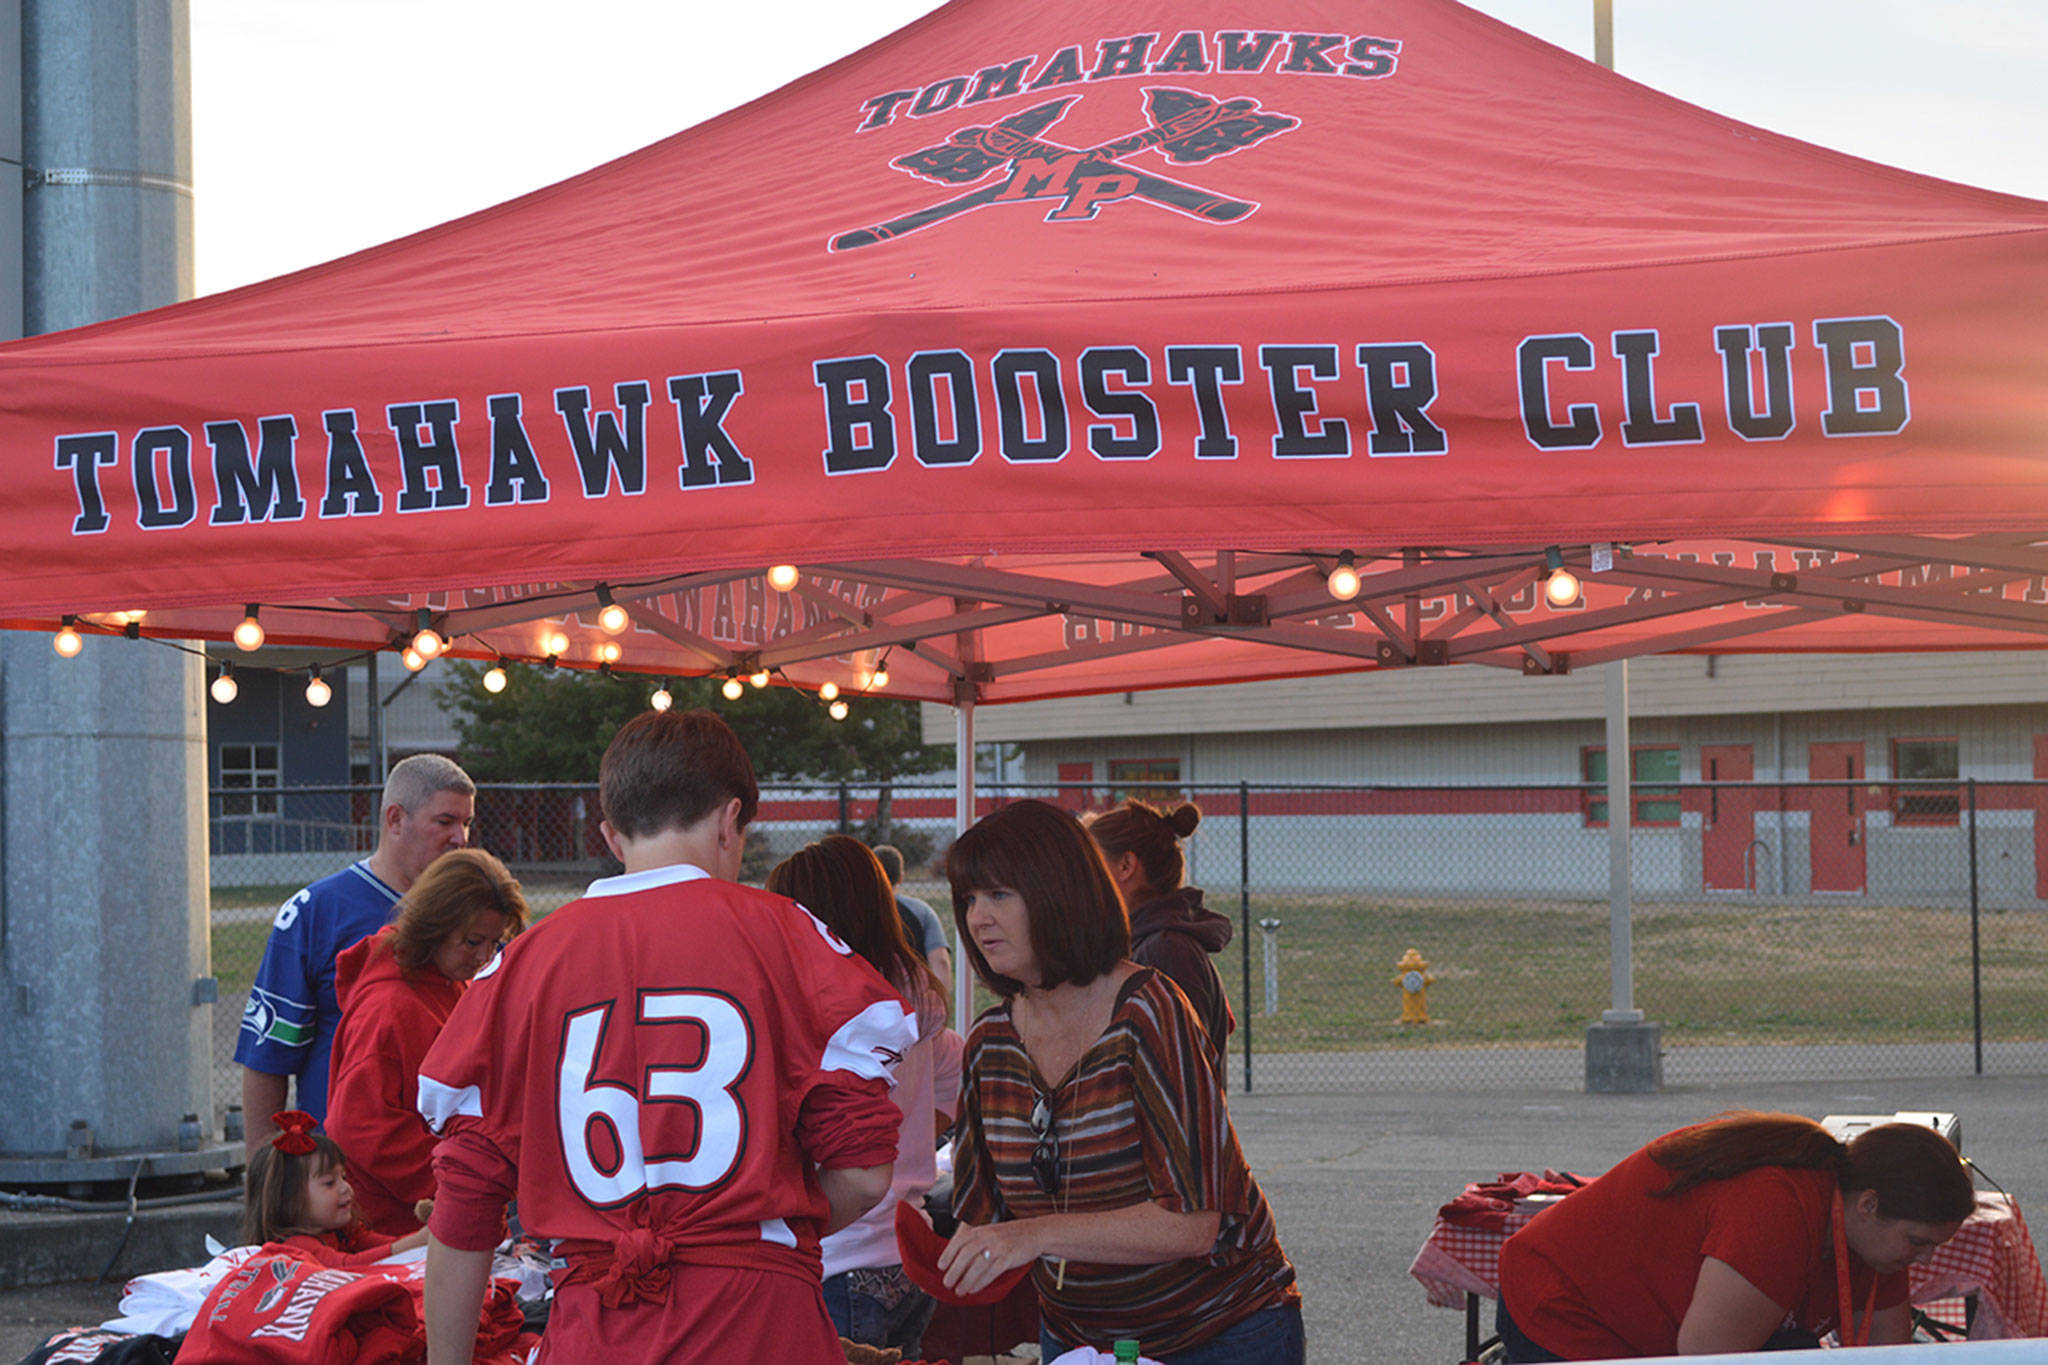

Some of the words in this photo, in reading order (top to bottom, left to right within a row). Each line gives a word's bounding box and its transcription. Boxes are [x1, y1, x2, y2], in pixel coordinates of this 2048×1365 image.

[855, 31, 1402, 133] TOMAHAWKS
[994, 152, 1139, 221] MP
[55, 371, 755, 534] TOMAHAWK
[813, 341, 1449, 476] BOOSTER
[1516, 315, 1911, 451] CLUB
[555, 987, 756, 1211] 63
